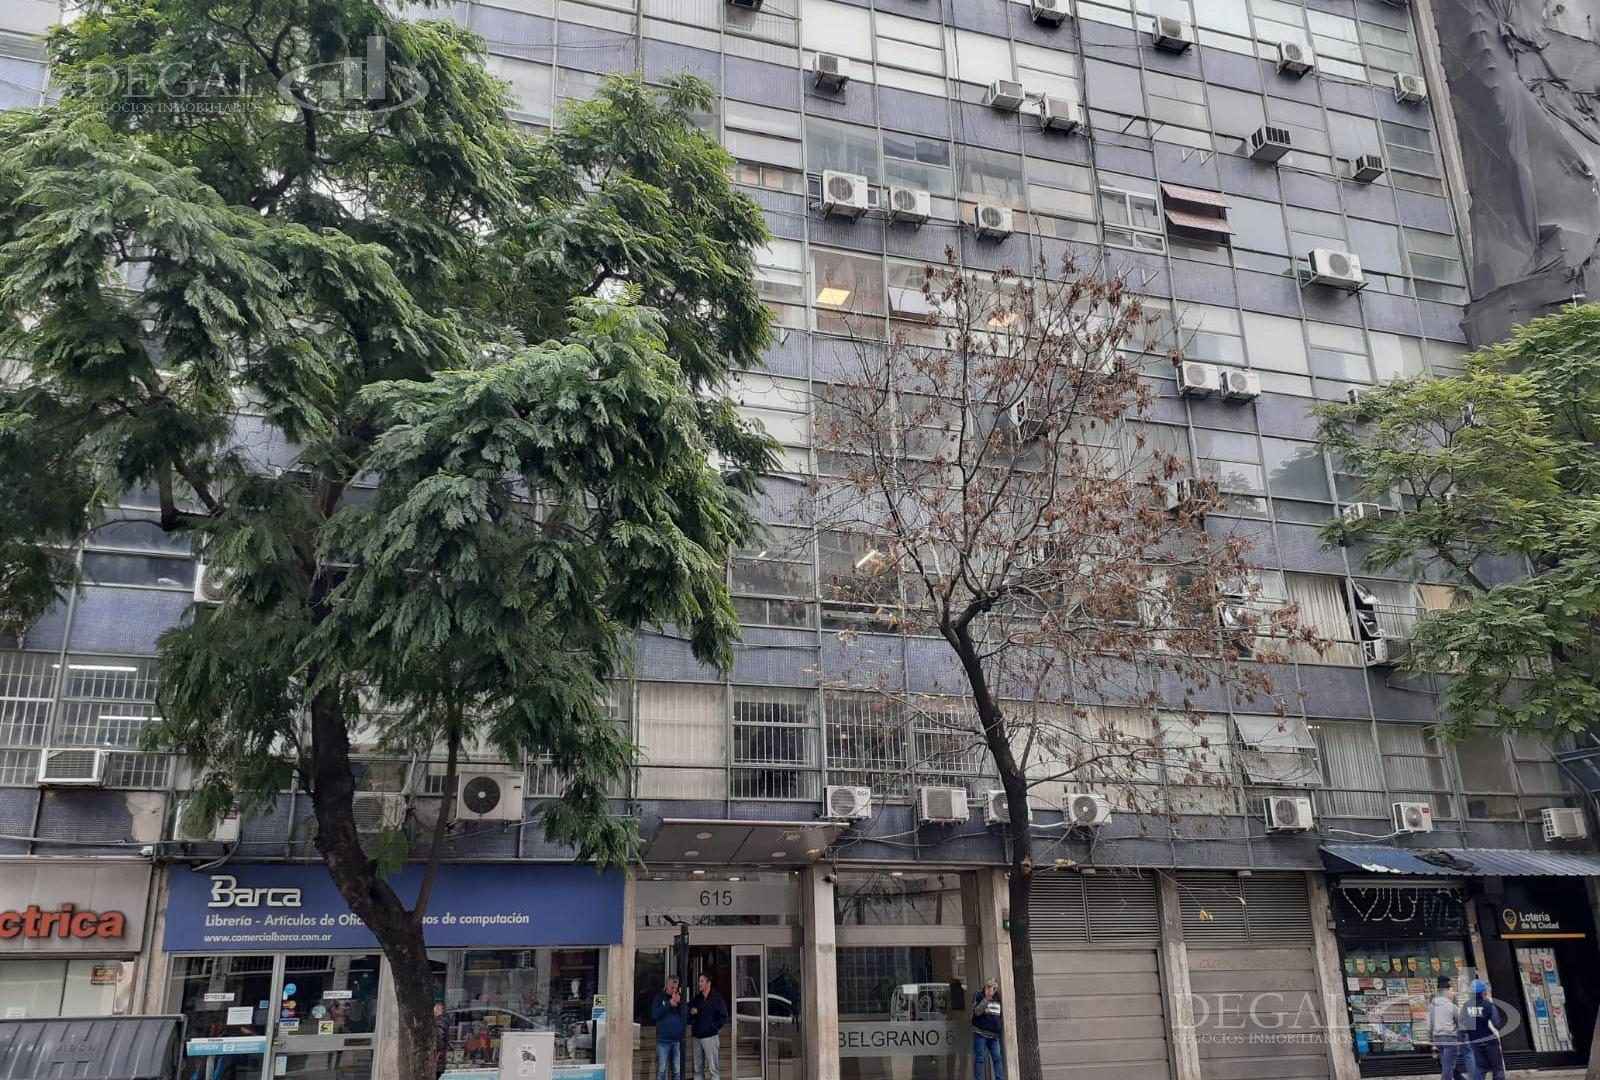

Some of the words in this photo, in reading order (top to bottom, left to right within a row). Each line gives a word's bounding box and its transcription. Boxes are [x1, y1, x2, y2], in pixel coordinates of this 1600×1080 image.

[207, 875, 302, 908] Barca
[699, 890, 733, 906] 615
[0, 903, 125, 939] ctrica
[205, 914, 252, 927] Librería
[264, 914, 316, 926] Artículos
[319, 913, 335, 926] de
[338, 913, 366, 926] Ofic
[441, 912, 457, 925] de
[459, 912, 530, 928] computación
[1519, 912, 1551, 922] Lotería
[1538, 921, 1560, 929] Ciudad
[203, 931, 332, 943] www.comercialbarca.com.ar
[838, 1029, 940, 1048] BELGRANO
